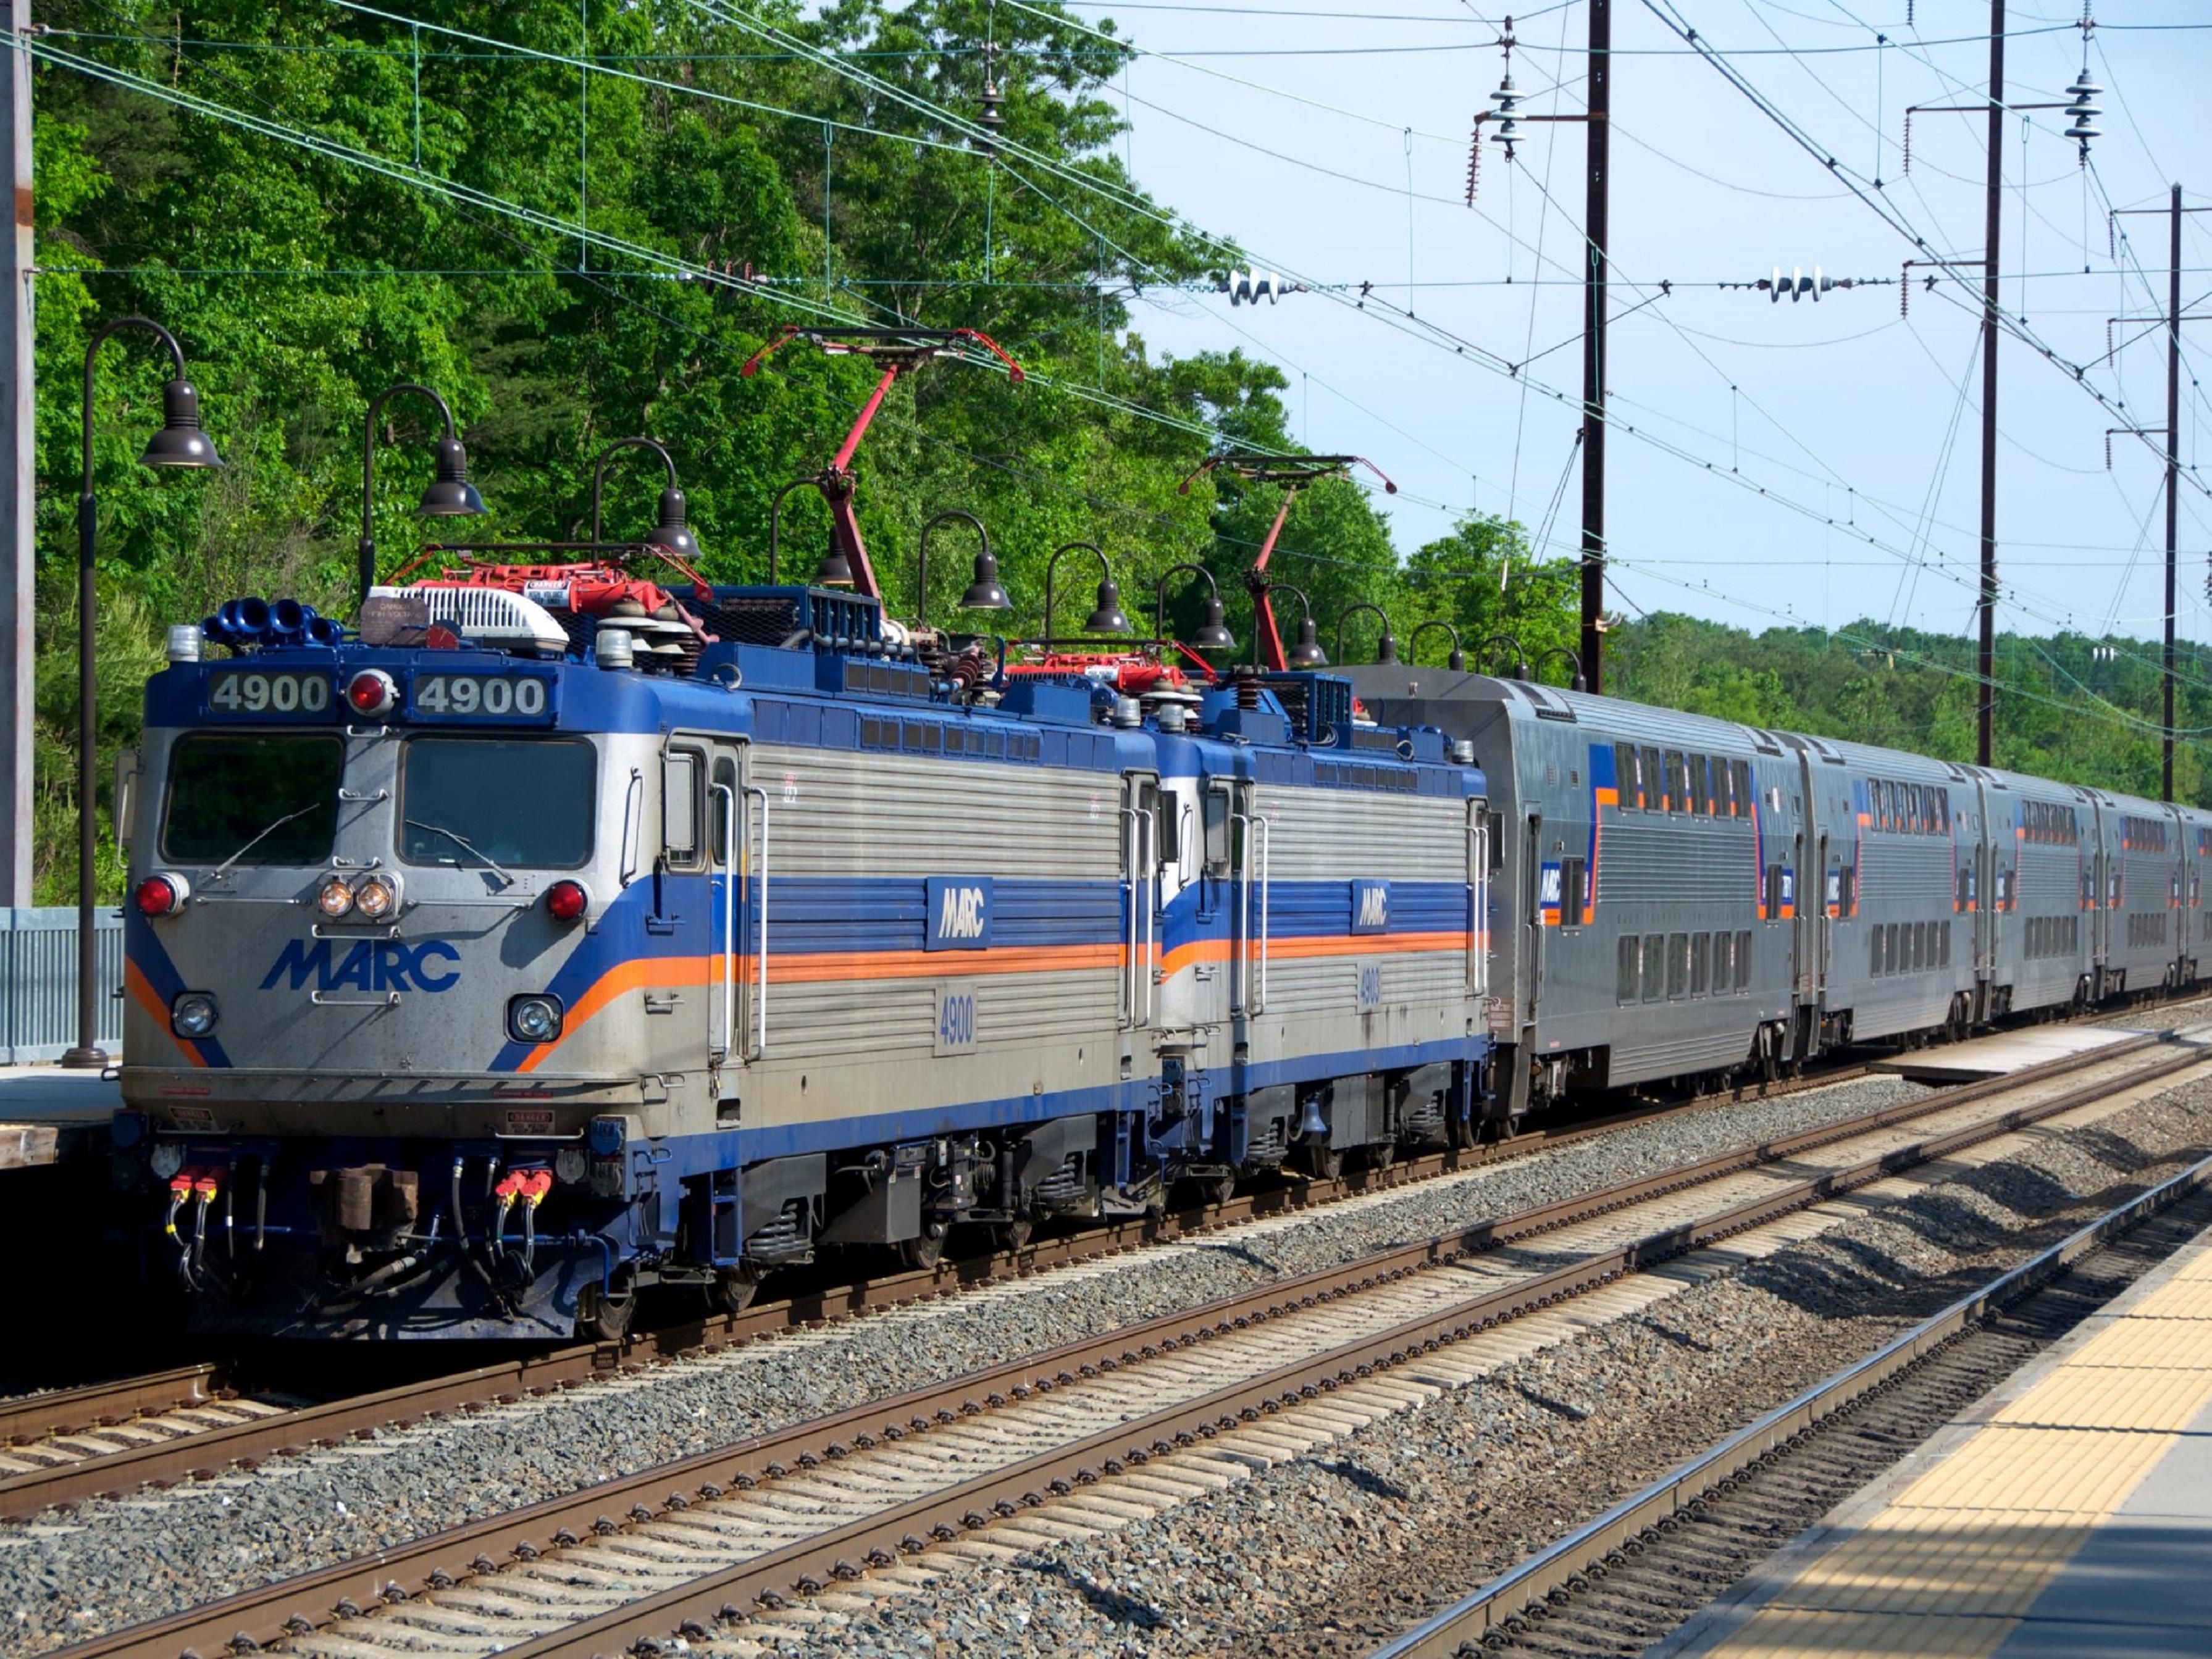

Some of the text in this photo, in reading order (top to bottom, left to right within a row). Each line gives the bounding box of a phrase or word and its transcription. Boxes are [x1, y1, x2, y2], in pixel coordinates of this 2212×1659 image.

[214, 675, 327, 712] 4900
[417, 677, 545, 714] 4900
[938, 887, 984, 938] MARC
[1359, 888, 1386, 926] MARC
[258, 939, 461, 992] MARC
[1361, 966, 1380, 1005] 4903
[941, 995, 973, 1045] 4900
[514, 1113, 546, 1121] DANGER
